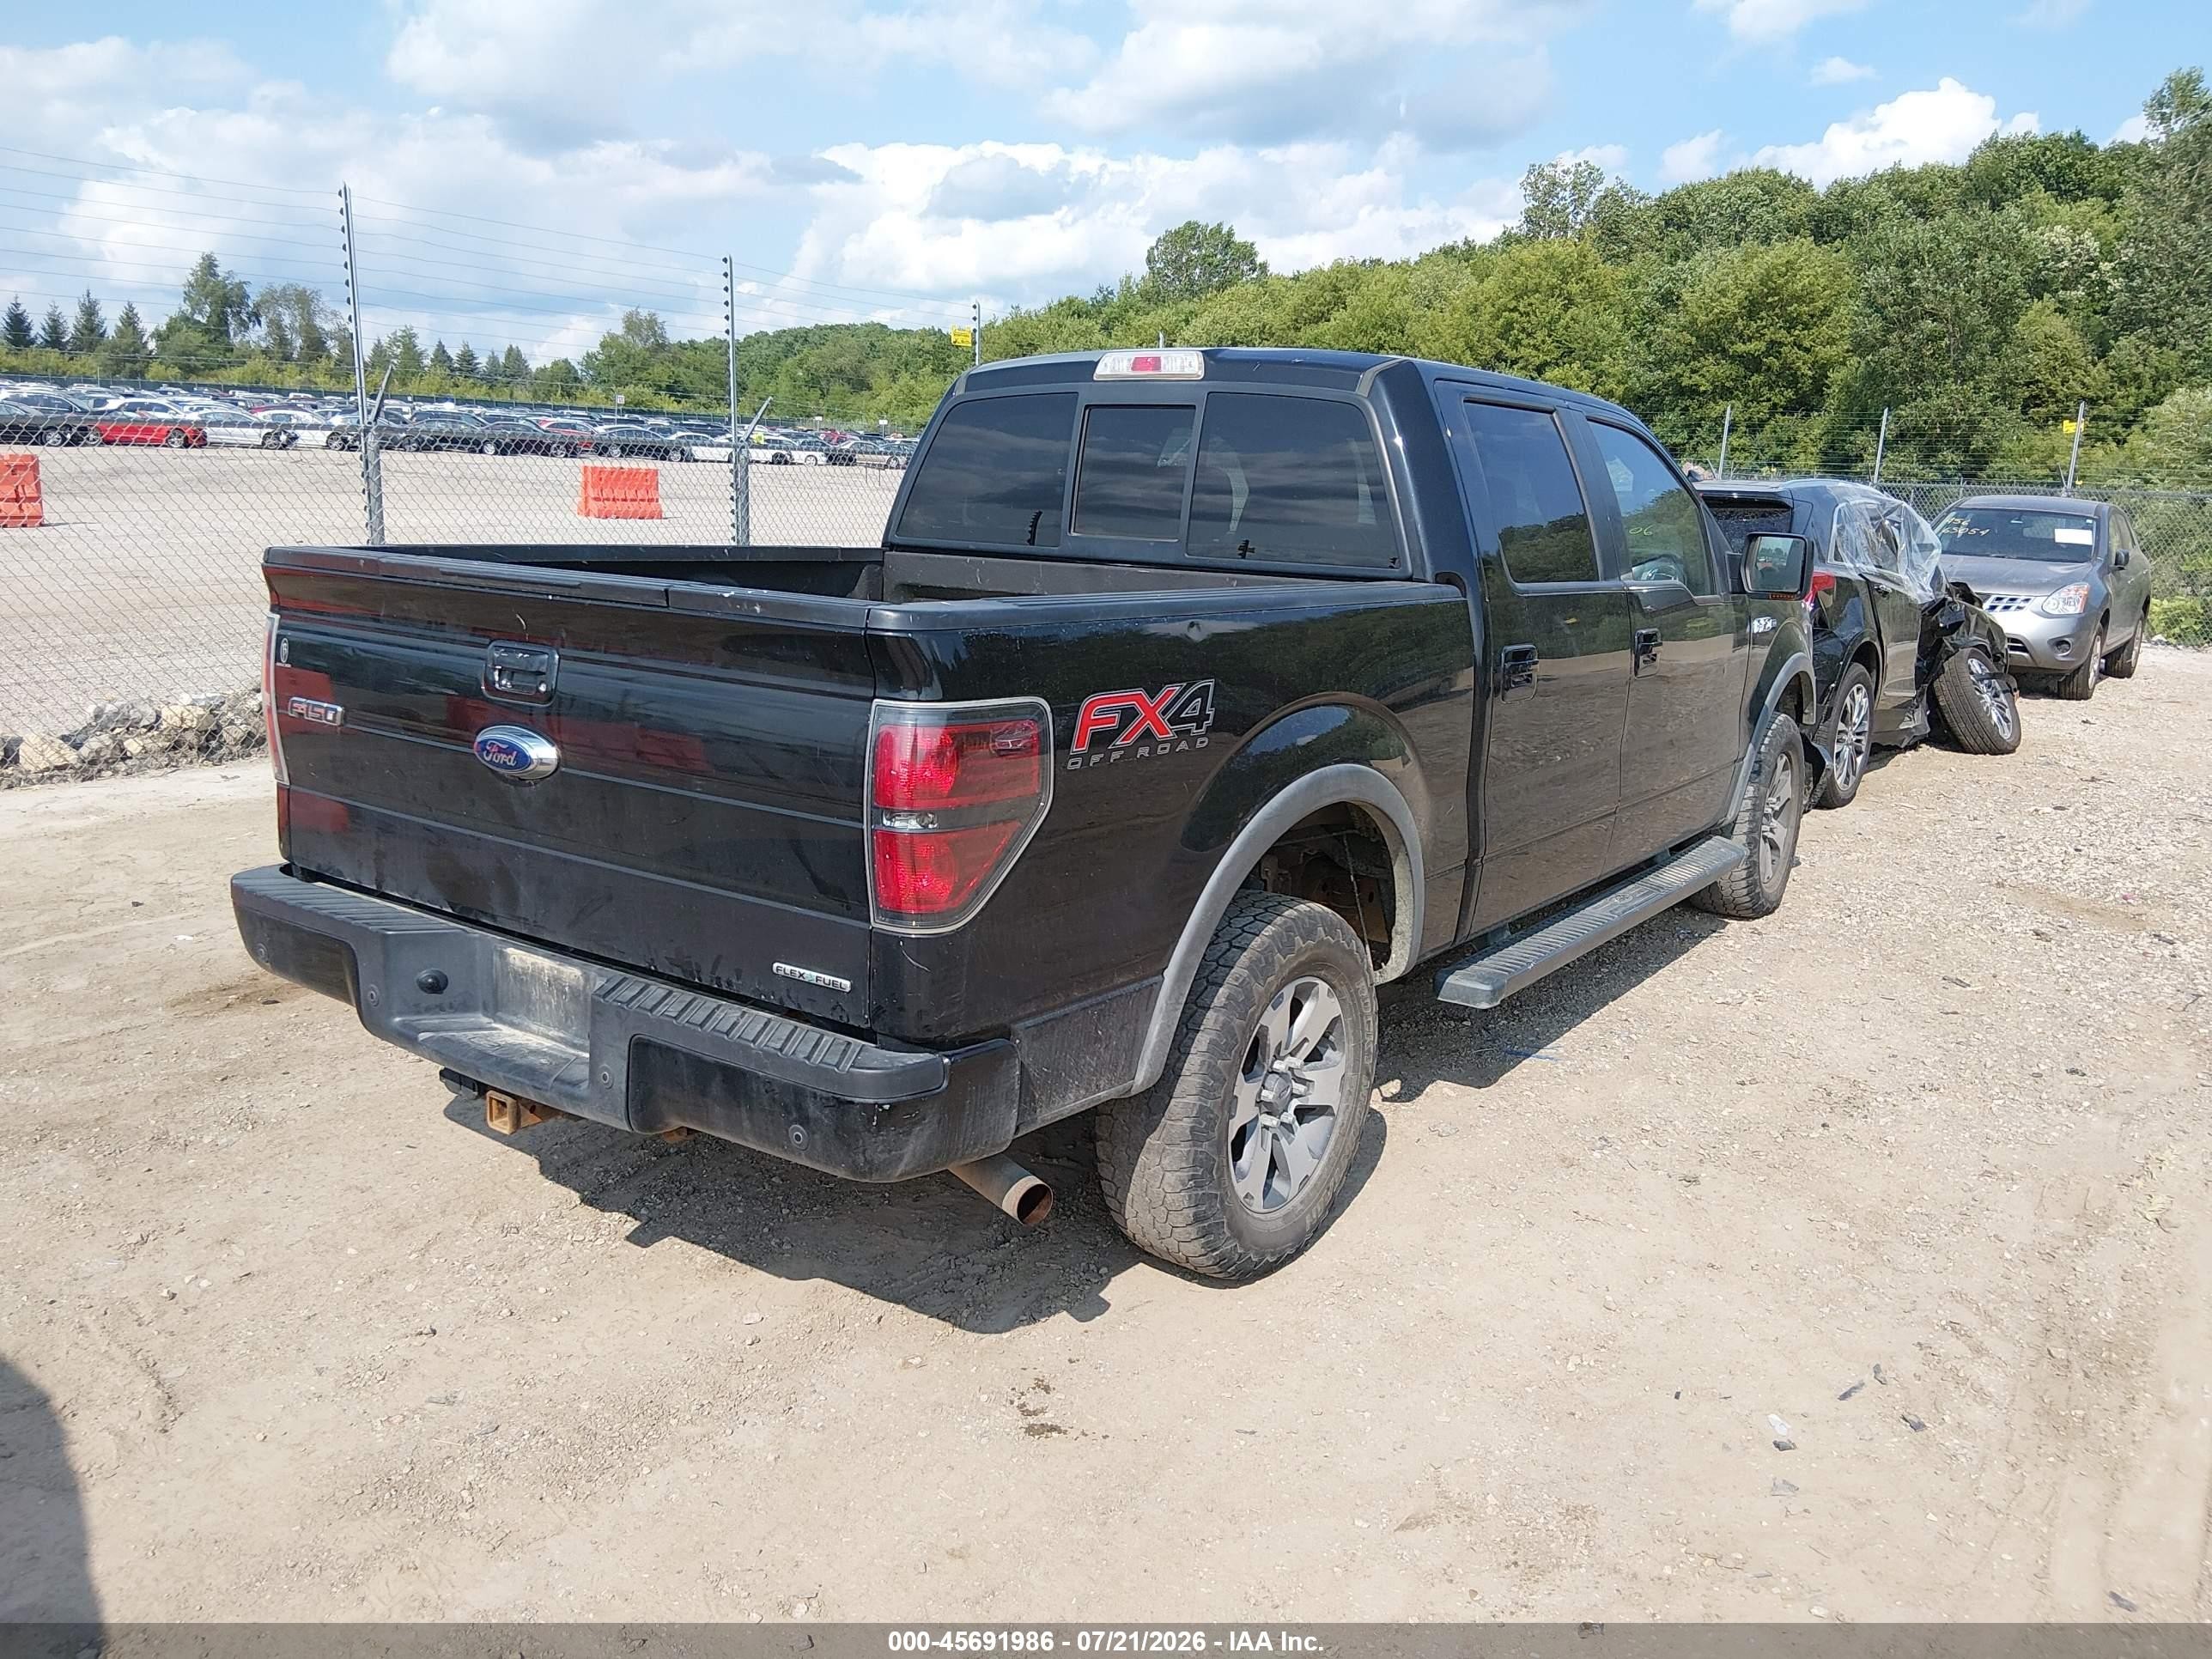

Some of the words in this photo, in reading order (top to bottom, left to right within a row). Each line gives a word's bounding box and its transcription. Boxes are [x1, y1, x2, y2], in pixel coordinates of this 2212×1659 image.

[1070, 678, 1215, 755] FX4
[483, 740, 517, 767] Ford
[1066, 750, 1125, 770] OFF
[1136, 736, 1209, 759] ROAD
[775, 964, 806, 980] FLEX
[815, 975, 848, 990] FUEL
